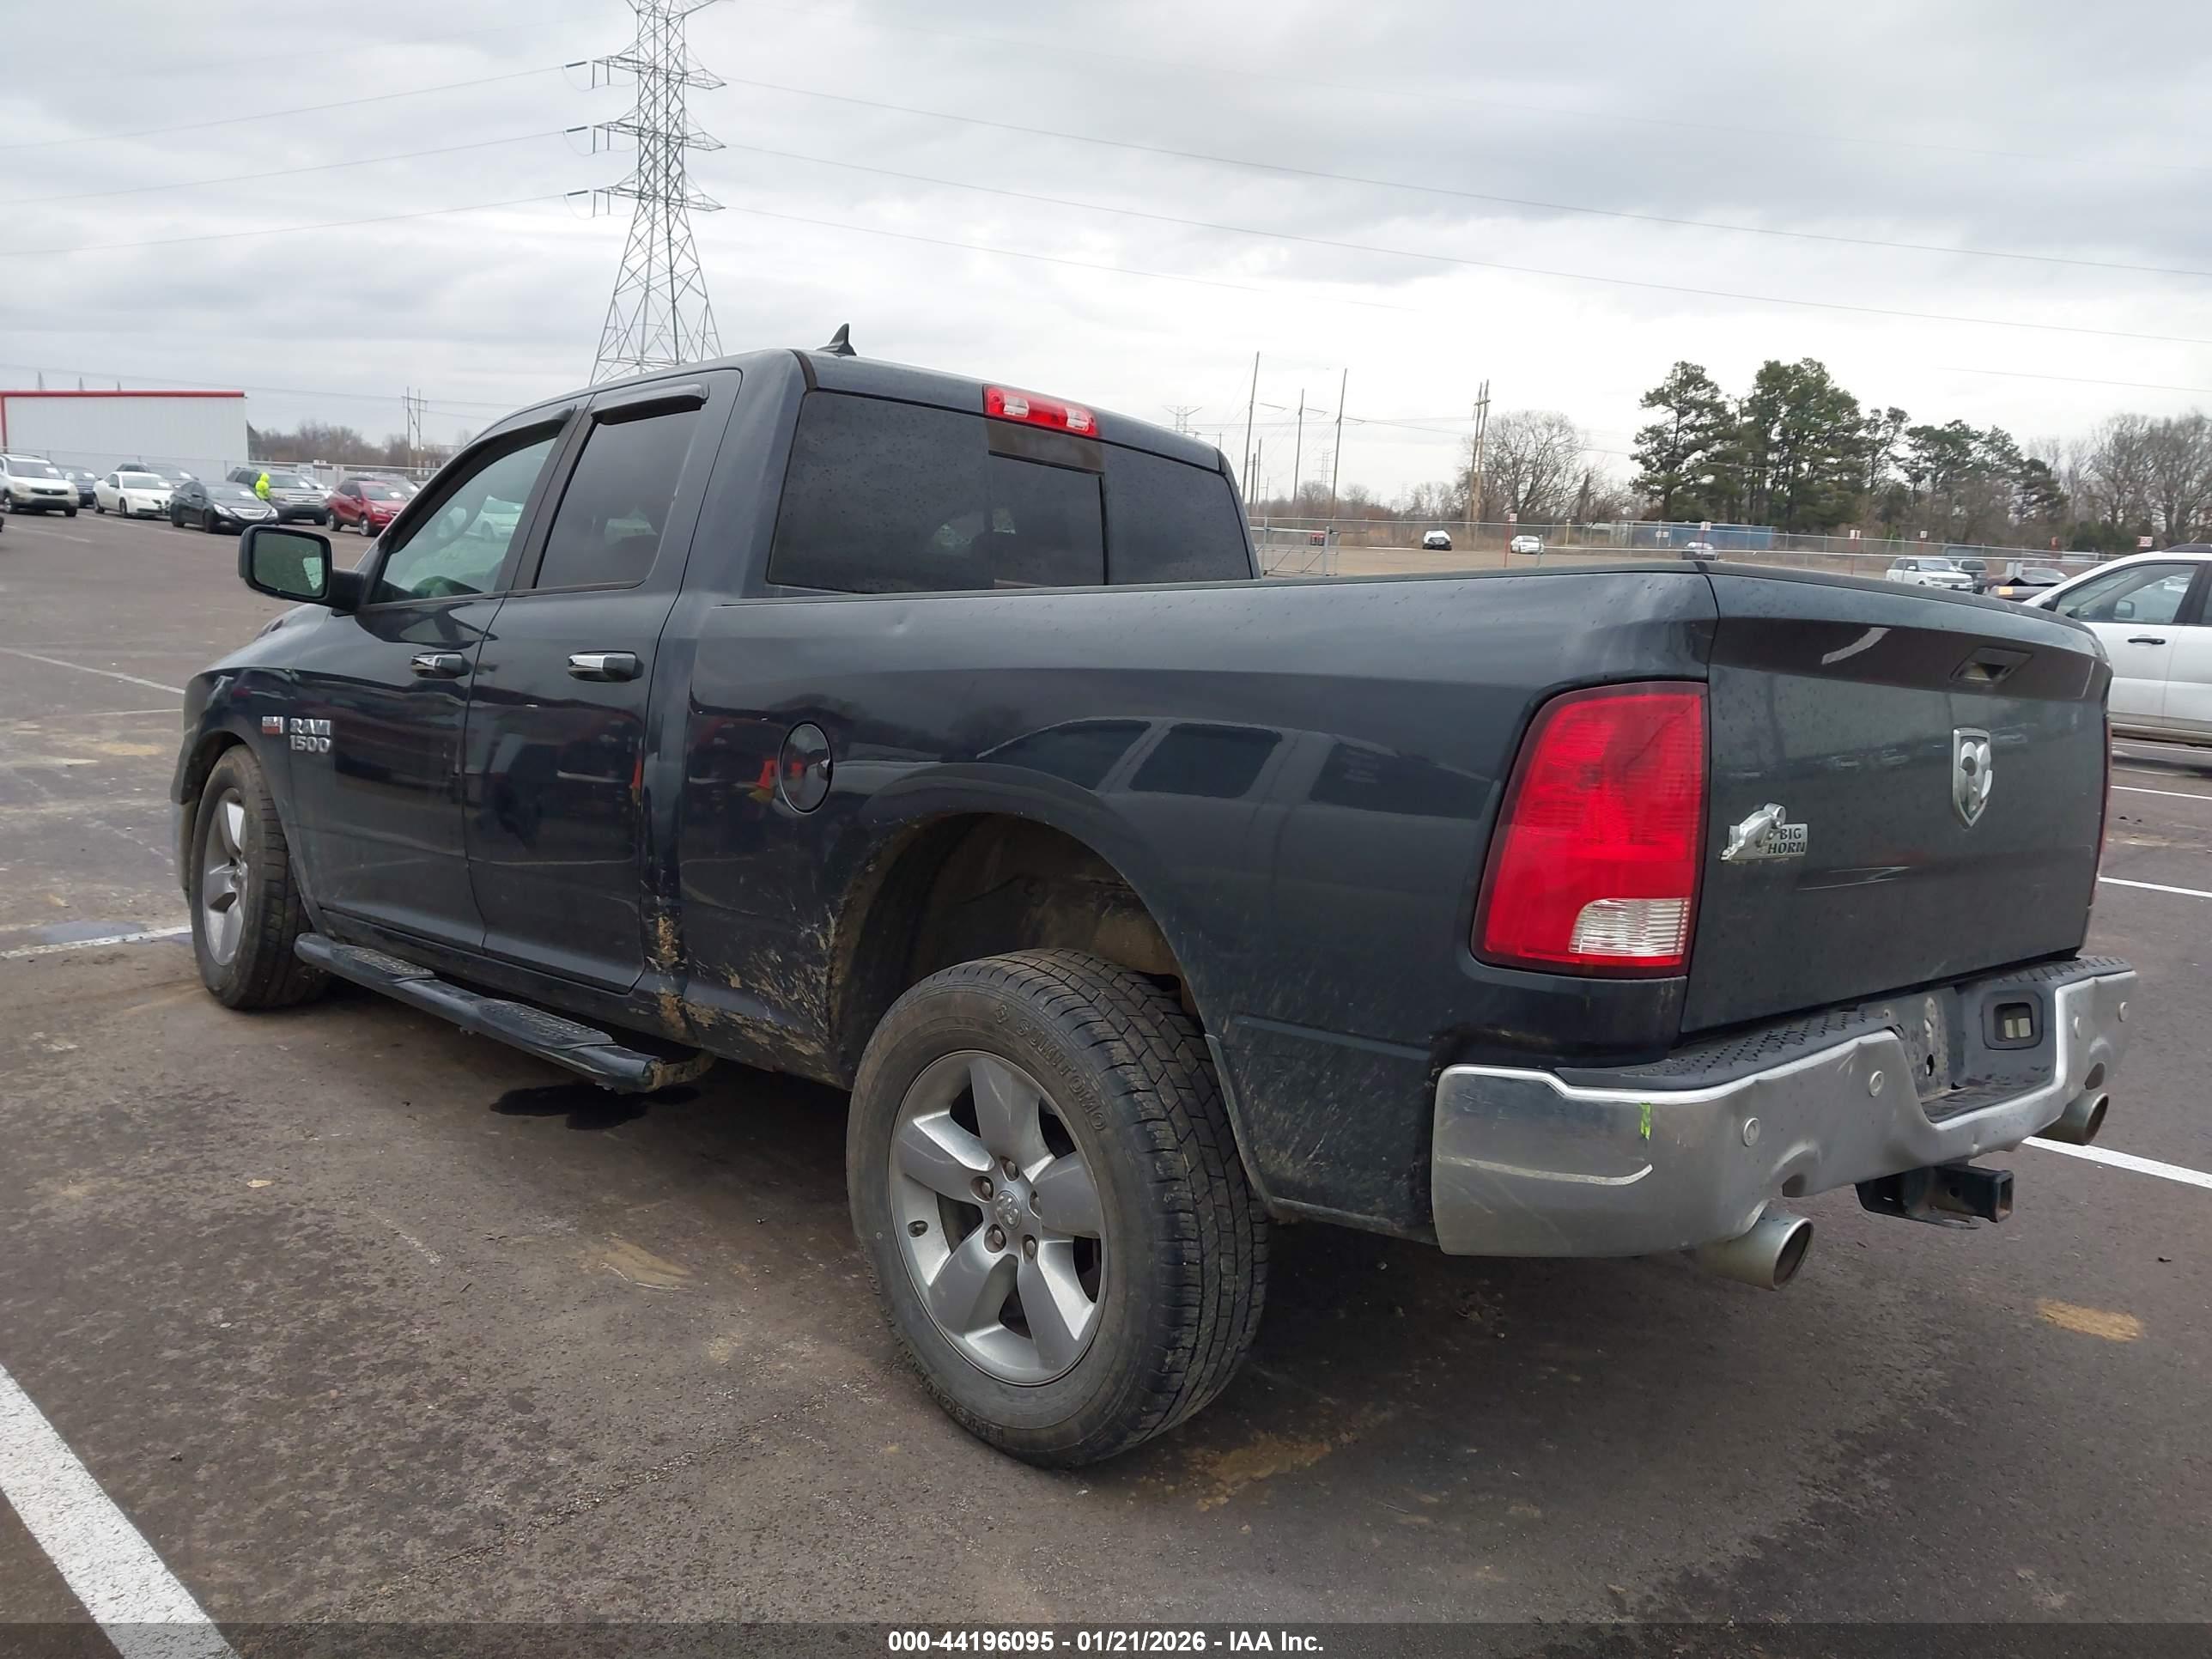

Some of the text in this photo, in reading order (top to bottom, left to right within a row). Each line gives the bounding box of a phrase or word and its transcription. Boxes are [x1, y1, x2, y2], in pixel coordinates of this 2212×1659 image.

[289, 718, 331, 736] RAM
[289, 734, 331, 753] 1500
[1779, 828, 1802, 841] BIG
[1767, 842, 1806, 854] HORN
[1016, 1017, 1107, 1132] SUMITOMO
